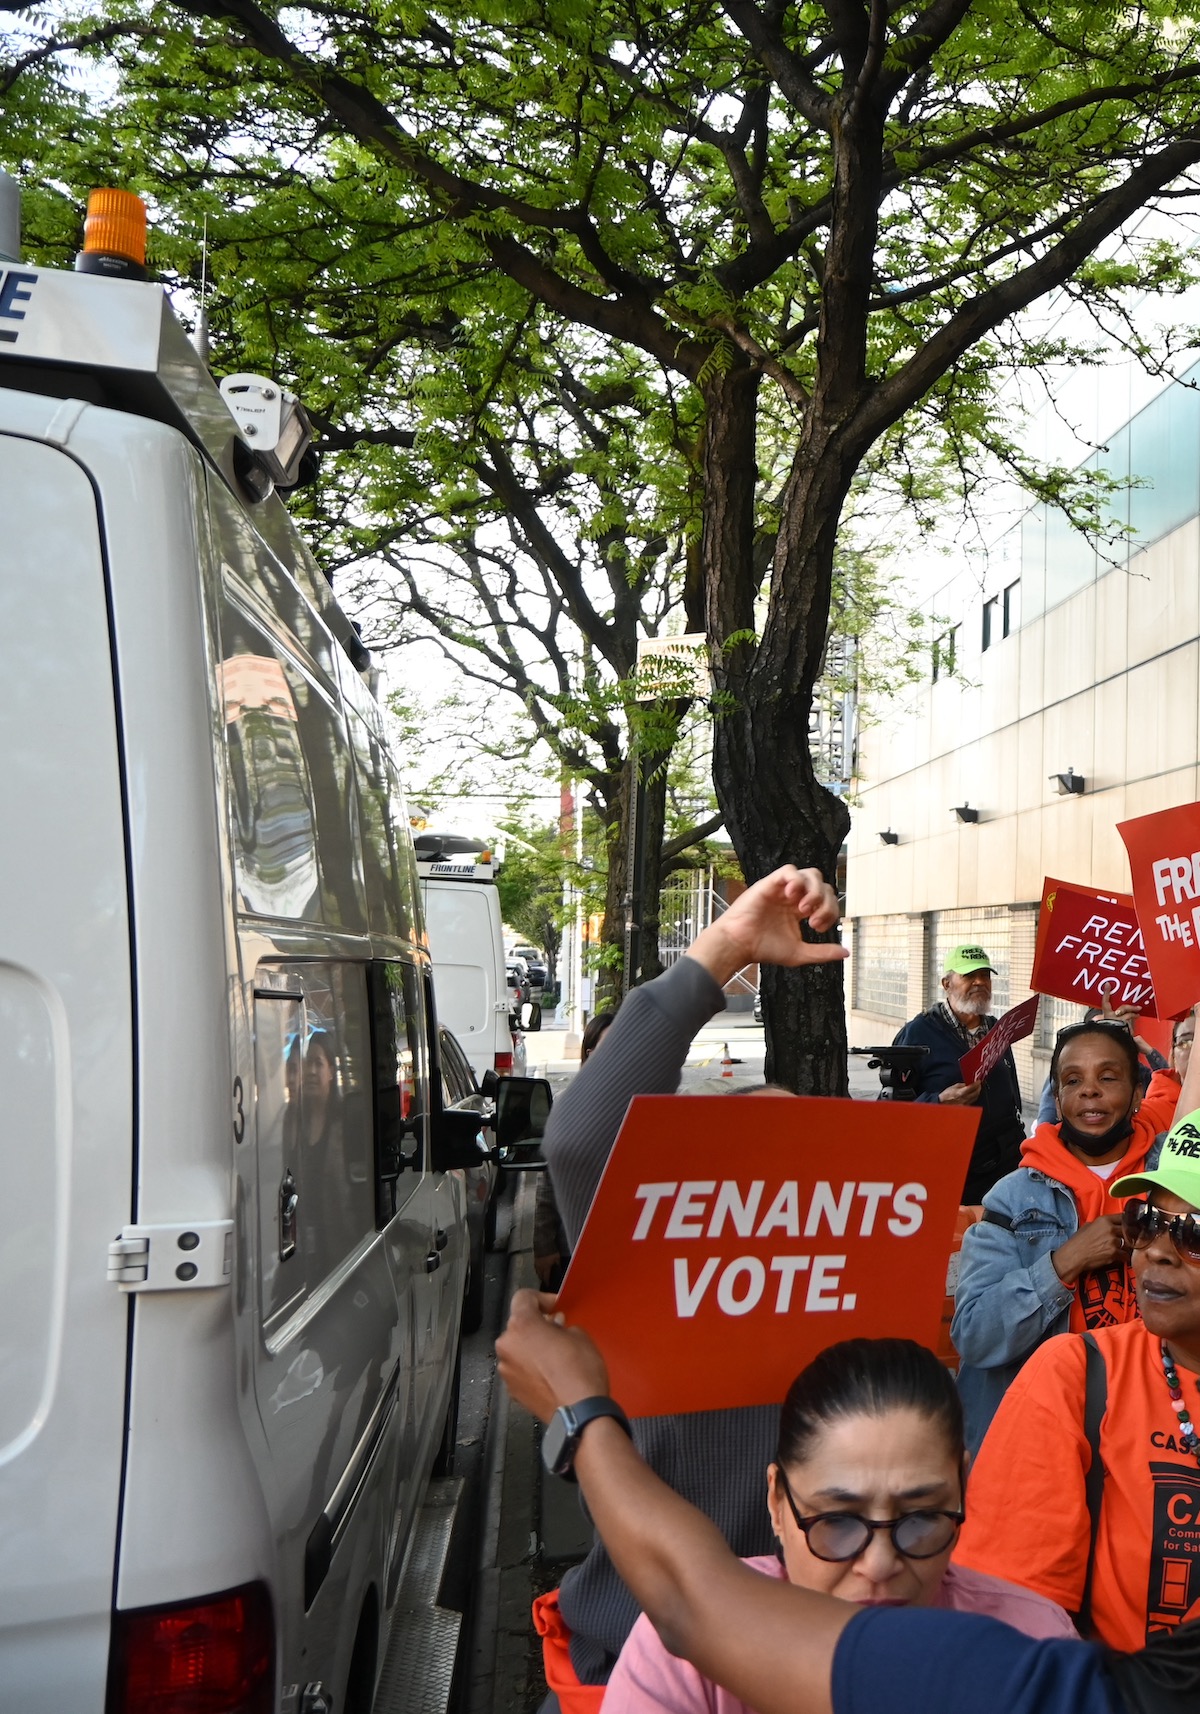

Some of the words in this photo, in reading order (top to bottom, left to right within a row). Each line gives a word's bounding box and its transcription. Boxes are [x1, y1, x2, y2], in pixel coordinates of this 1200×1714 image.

[430, 864, 476, 874] FRONTLINE
[1155, 913, 1194, 948] THE
[1055, 934, 1152, 980] FREE
[1072, 967, 1156, 1005] NOW!
[233, 1075, 245, 1145] 3
[632, 1180, 928, 1241] TENANTS
[673, 1254, 857, 1318] VOTE.
[1163, 1539, 1180, 1551] for
